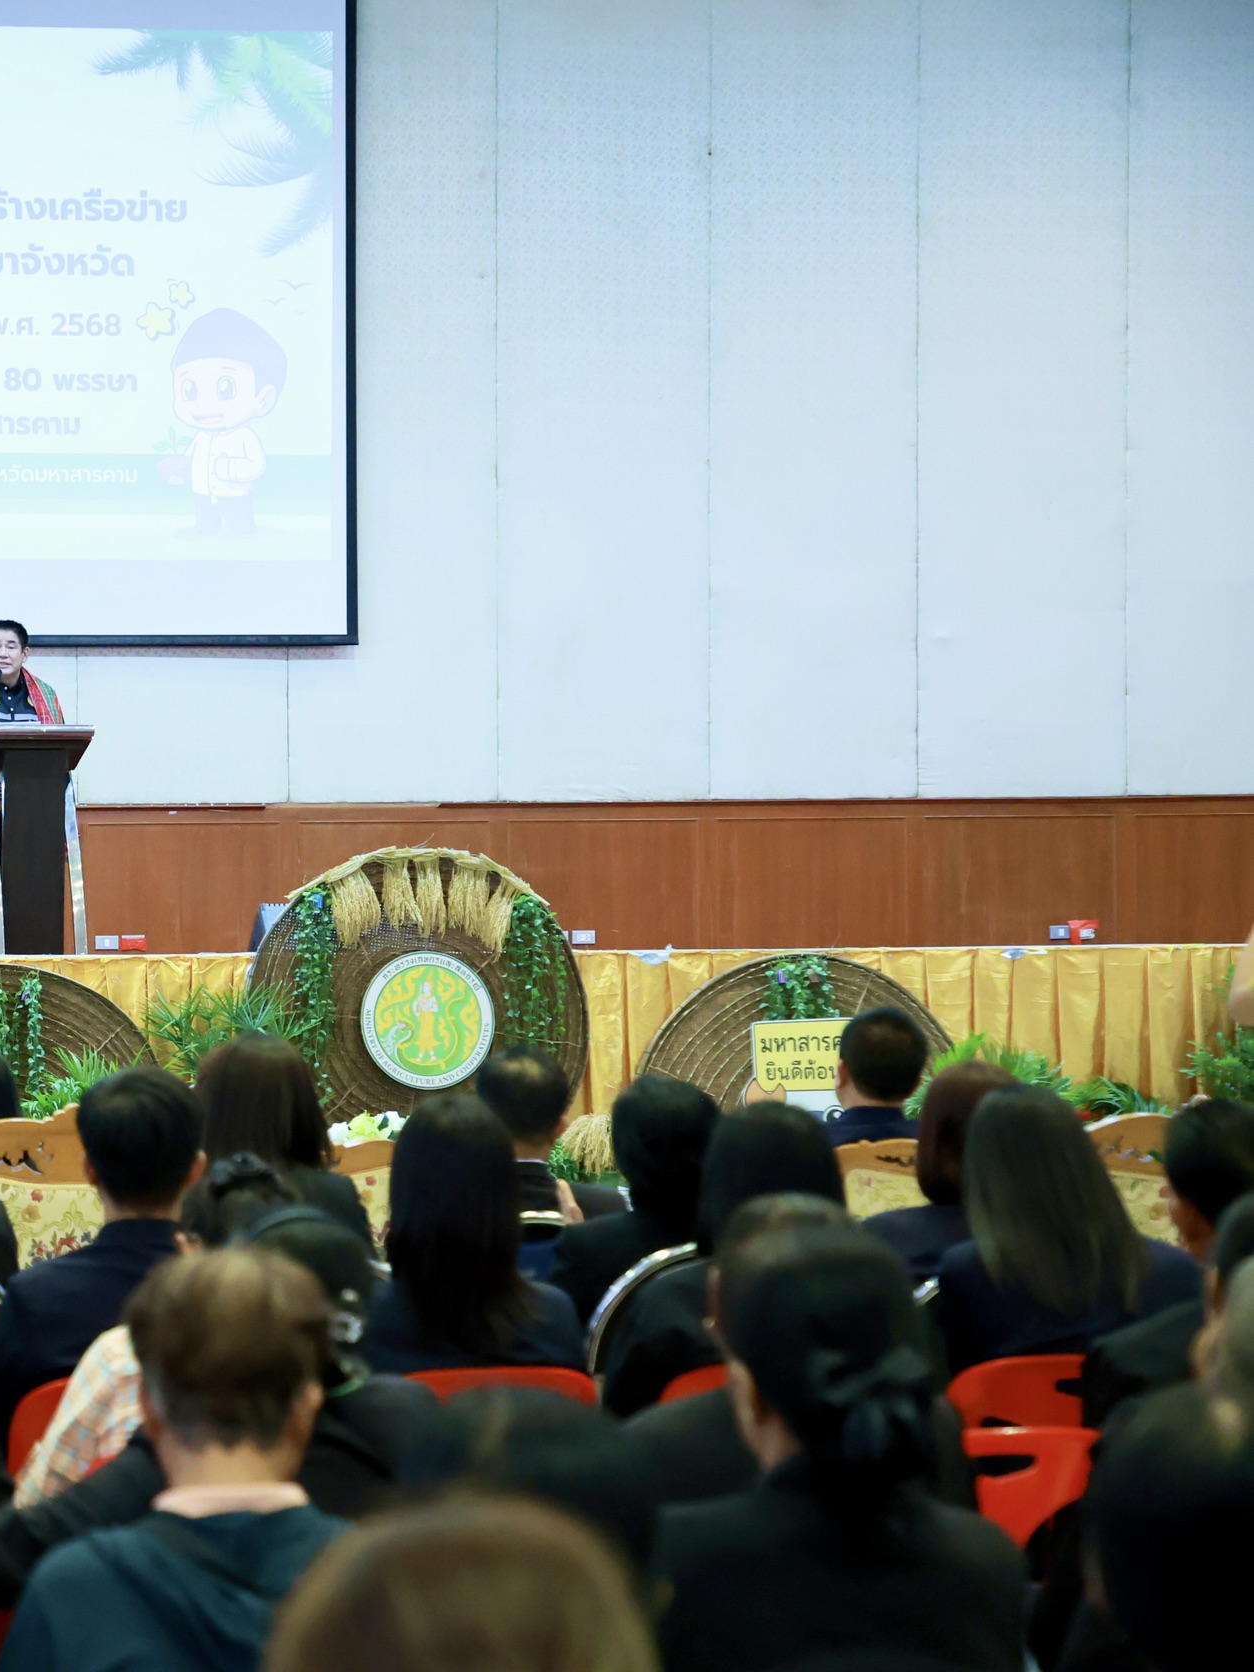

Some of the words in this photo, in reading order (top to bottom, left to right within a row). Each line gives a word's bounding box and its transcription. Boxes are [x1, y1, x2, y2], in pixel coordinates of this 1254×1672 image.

[50, 312, 122, 337] 2568
[3, 367, 42, 392] 80
[52, 372, 139, 393] พรรษา
[365, 1008, 377, 1050] MINISTRY
[376, 1049, 386, 1063] OF
[385, 1061, 435, 1086] AGRICULTURE
[438, 1073, 455, 1084] AND
[455, 1022, 490, 1077] COOPERATIVES
[760, 1035, 843, 1054] มหาสารค
